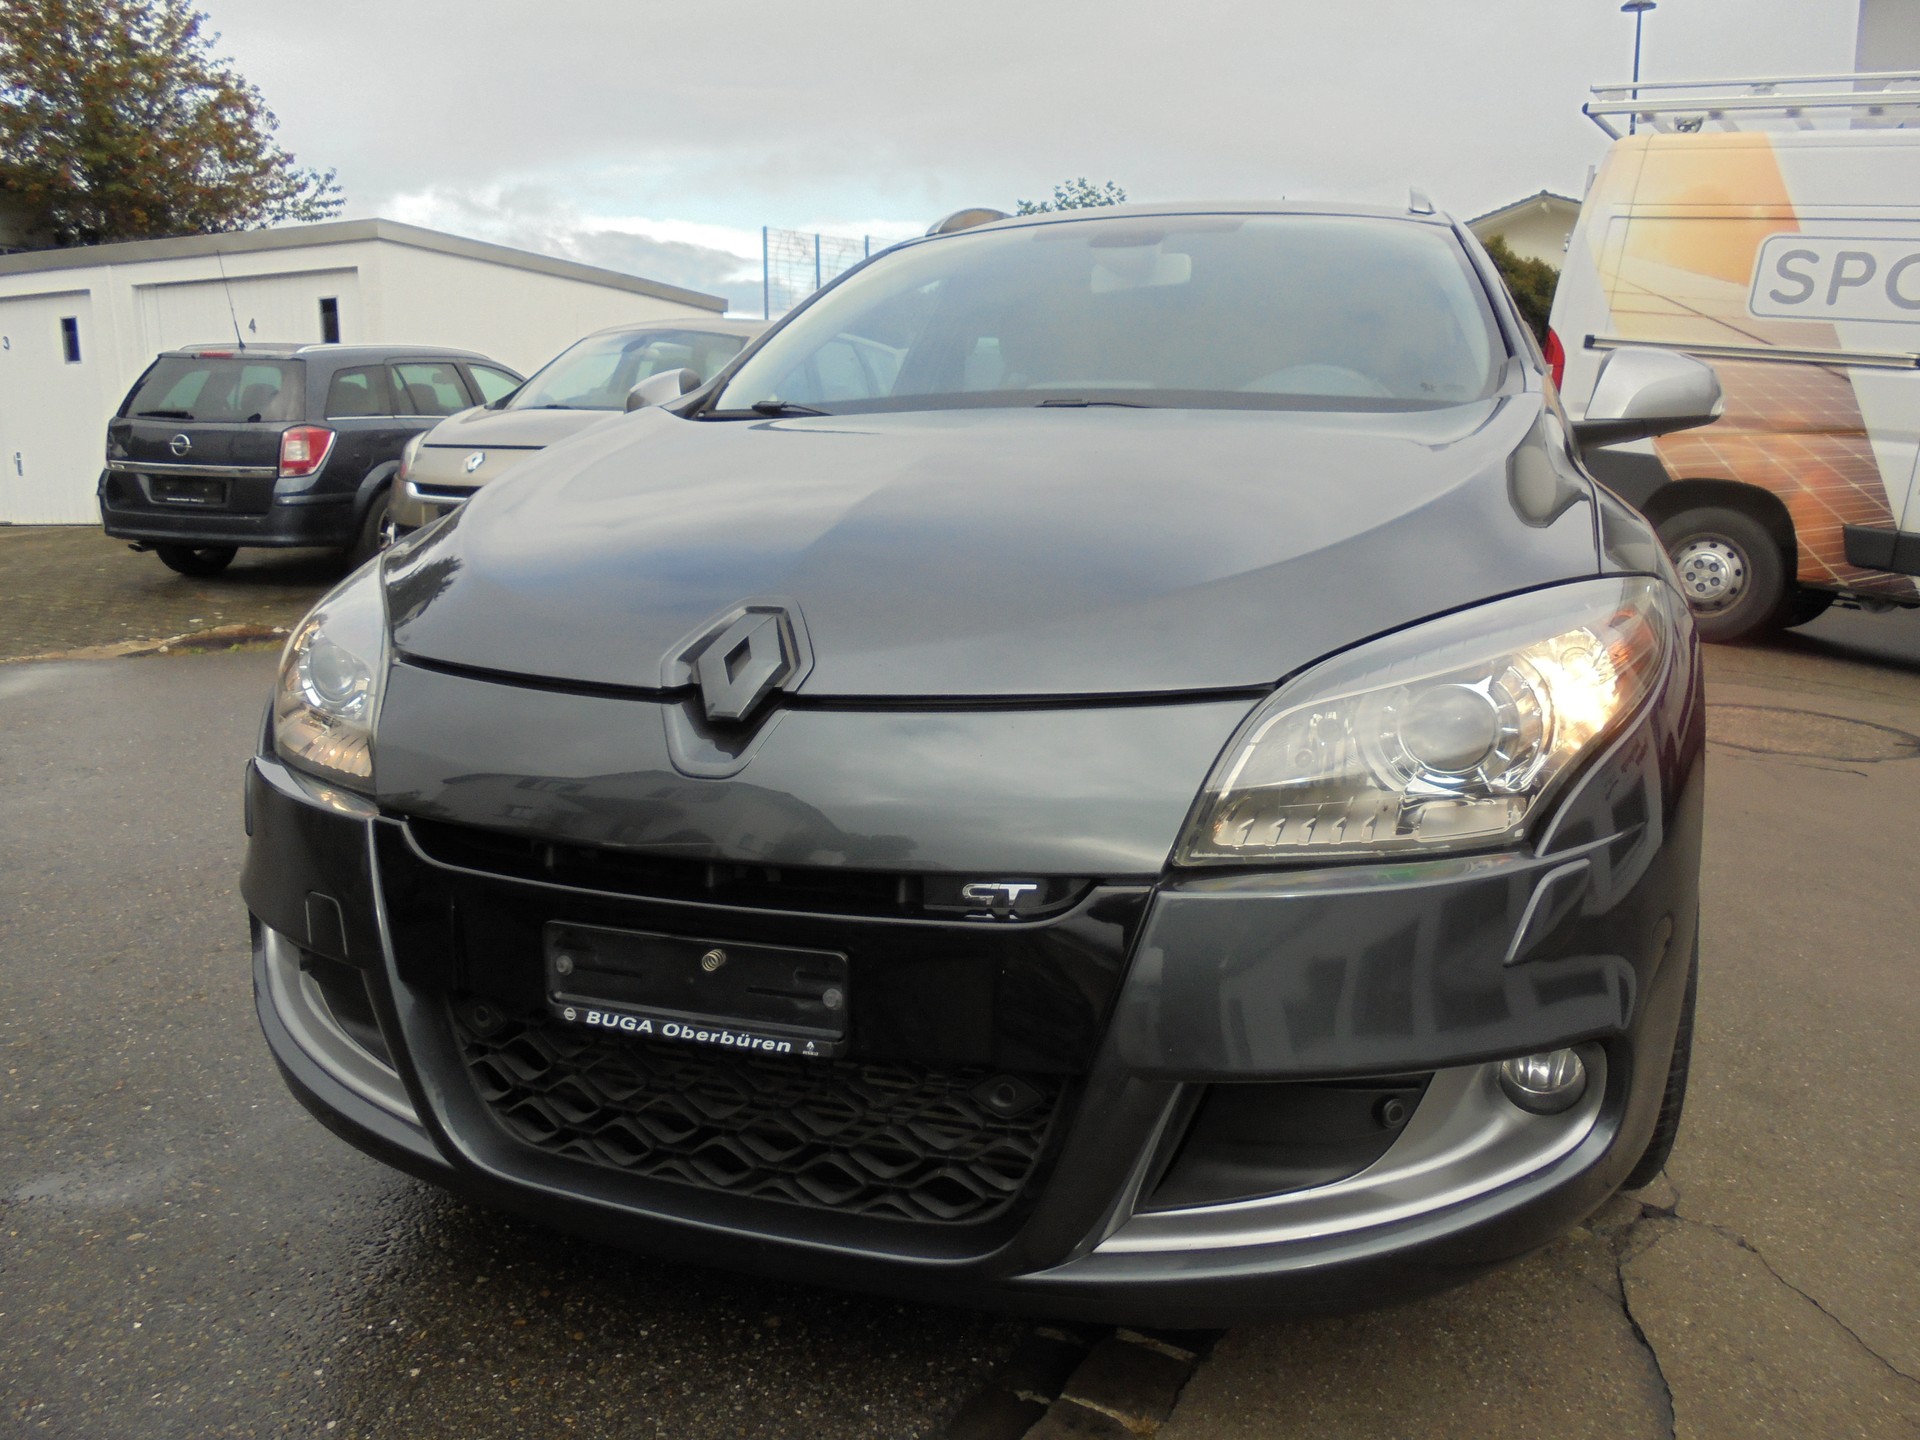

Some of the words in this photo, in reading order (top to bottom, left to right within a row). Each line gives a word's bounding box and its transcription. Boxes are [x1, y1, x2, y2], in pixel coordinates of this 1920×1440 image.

[248, 318, 256, 333] 4
[2, 335, 10, 350] 3
[586, 1010, 653, 1033] BUGA
[662, 1023, 791, 1053] Oberbüren
